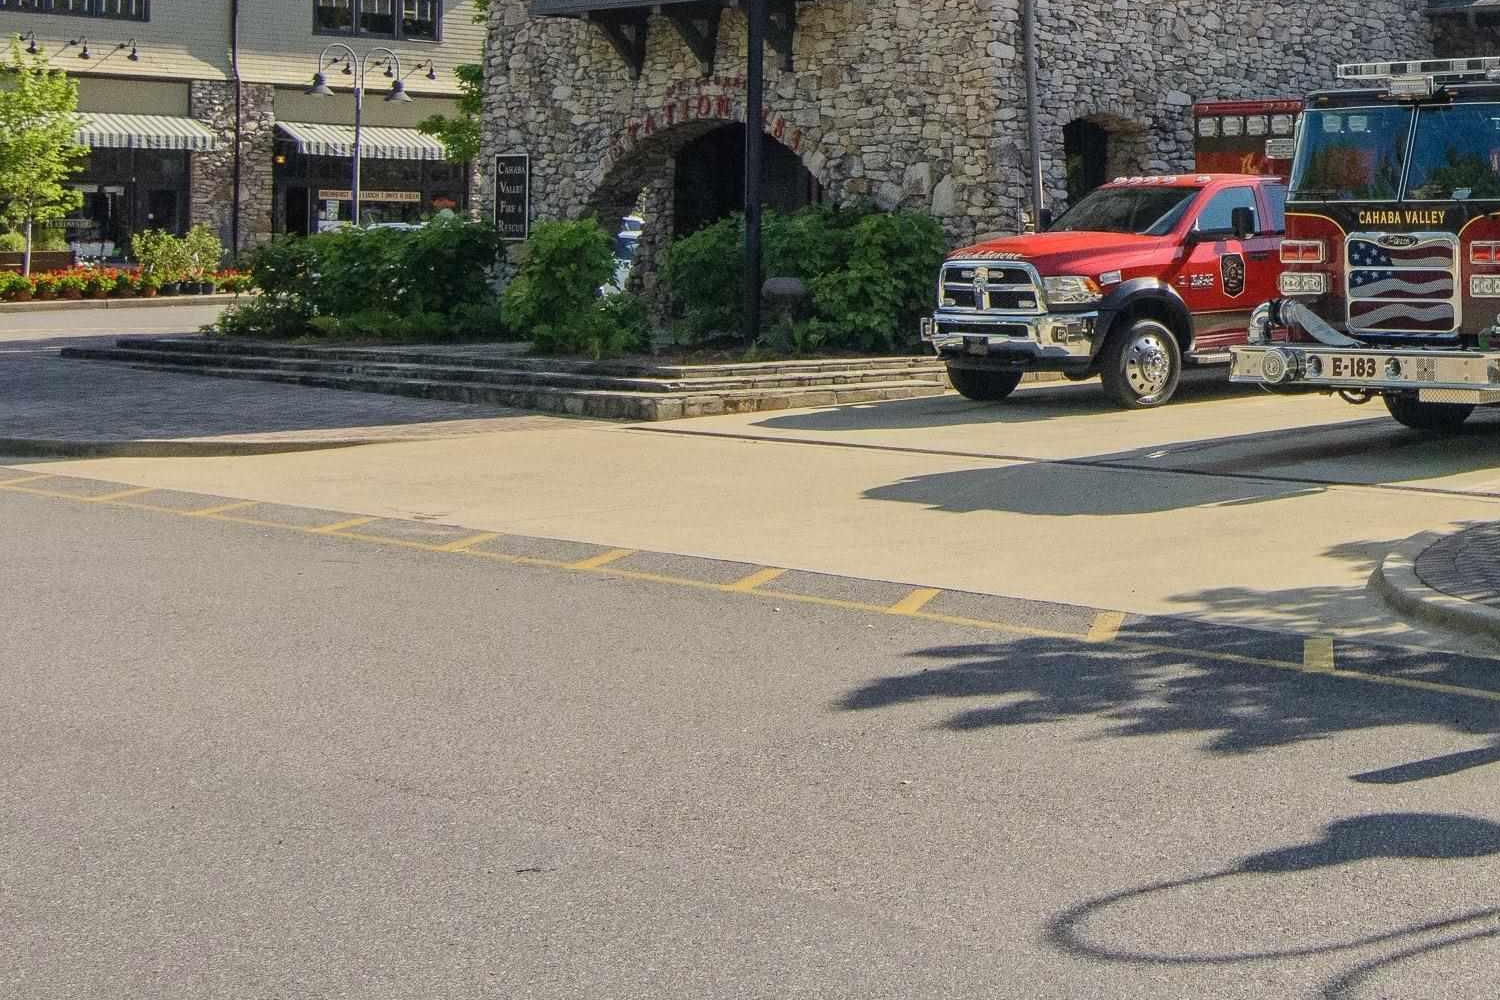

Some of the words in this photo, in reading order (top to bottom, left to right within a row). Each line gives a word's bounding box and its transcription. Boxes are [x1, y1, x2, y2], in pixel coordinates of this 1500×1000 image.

[1359, 210, 1401, 225] CAHABA
[1404, 210, 1446, 225] VALLEY
[1332, 357, 1376, 377] E-183
